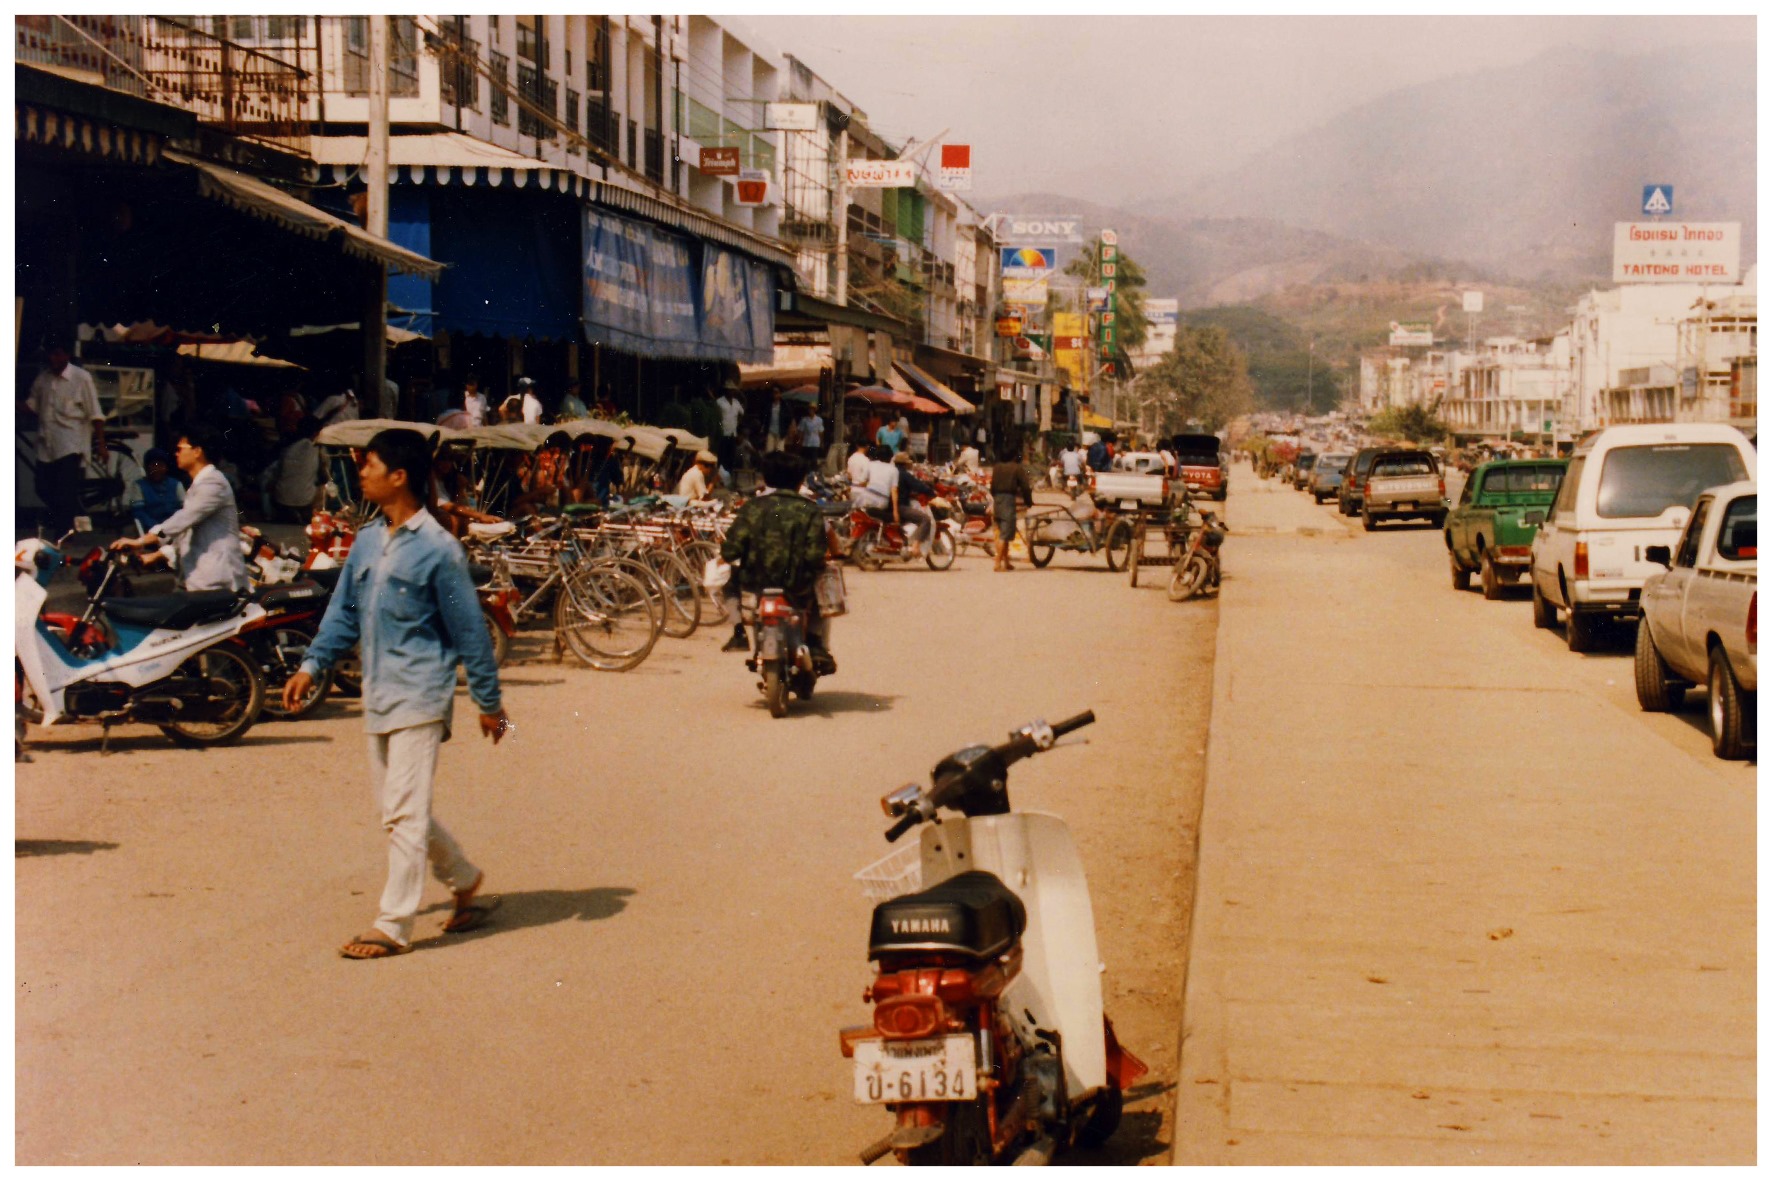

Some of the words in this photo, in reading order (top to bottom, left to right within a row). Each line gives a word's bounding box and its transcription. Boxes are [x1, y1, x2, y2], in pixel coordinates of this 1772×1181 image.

[703, 157, 737, 169] Triumph
[1012, 220, 1076, 235] SONY
[1629, 225, 1678, 241] โรงแรม
[1623, 264, 1680, 276] TAITONG
[1686, 264, 1729, 276] HOTEL
[890, 918, 951, 934] YAMAHA
